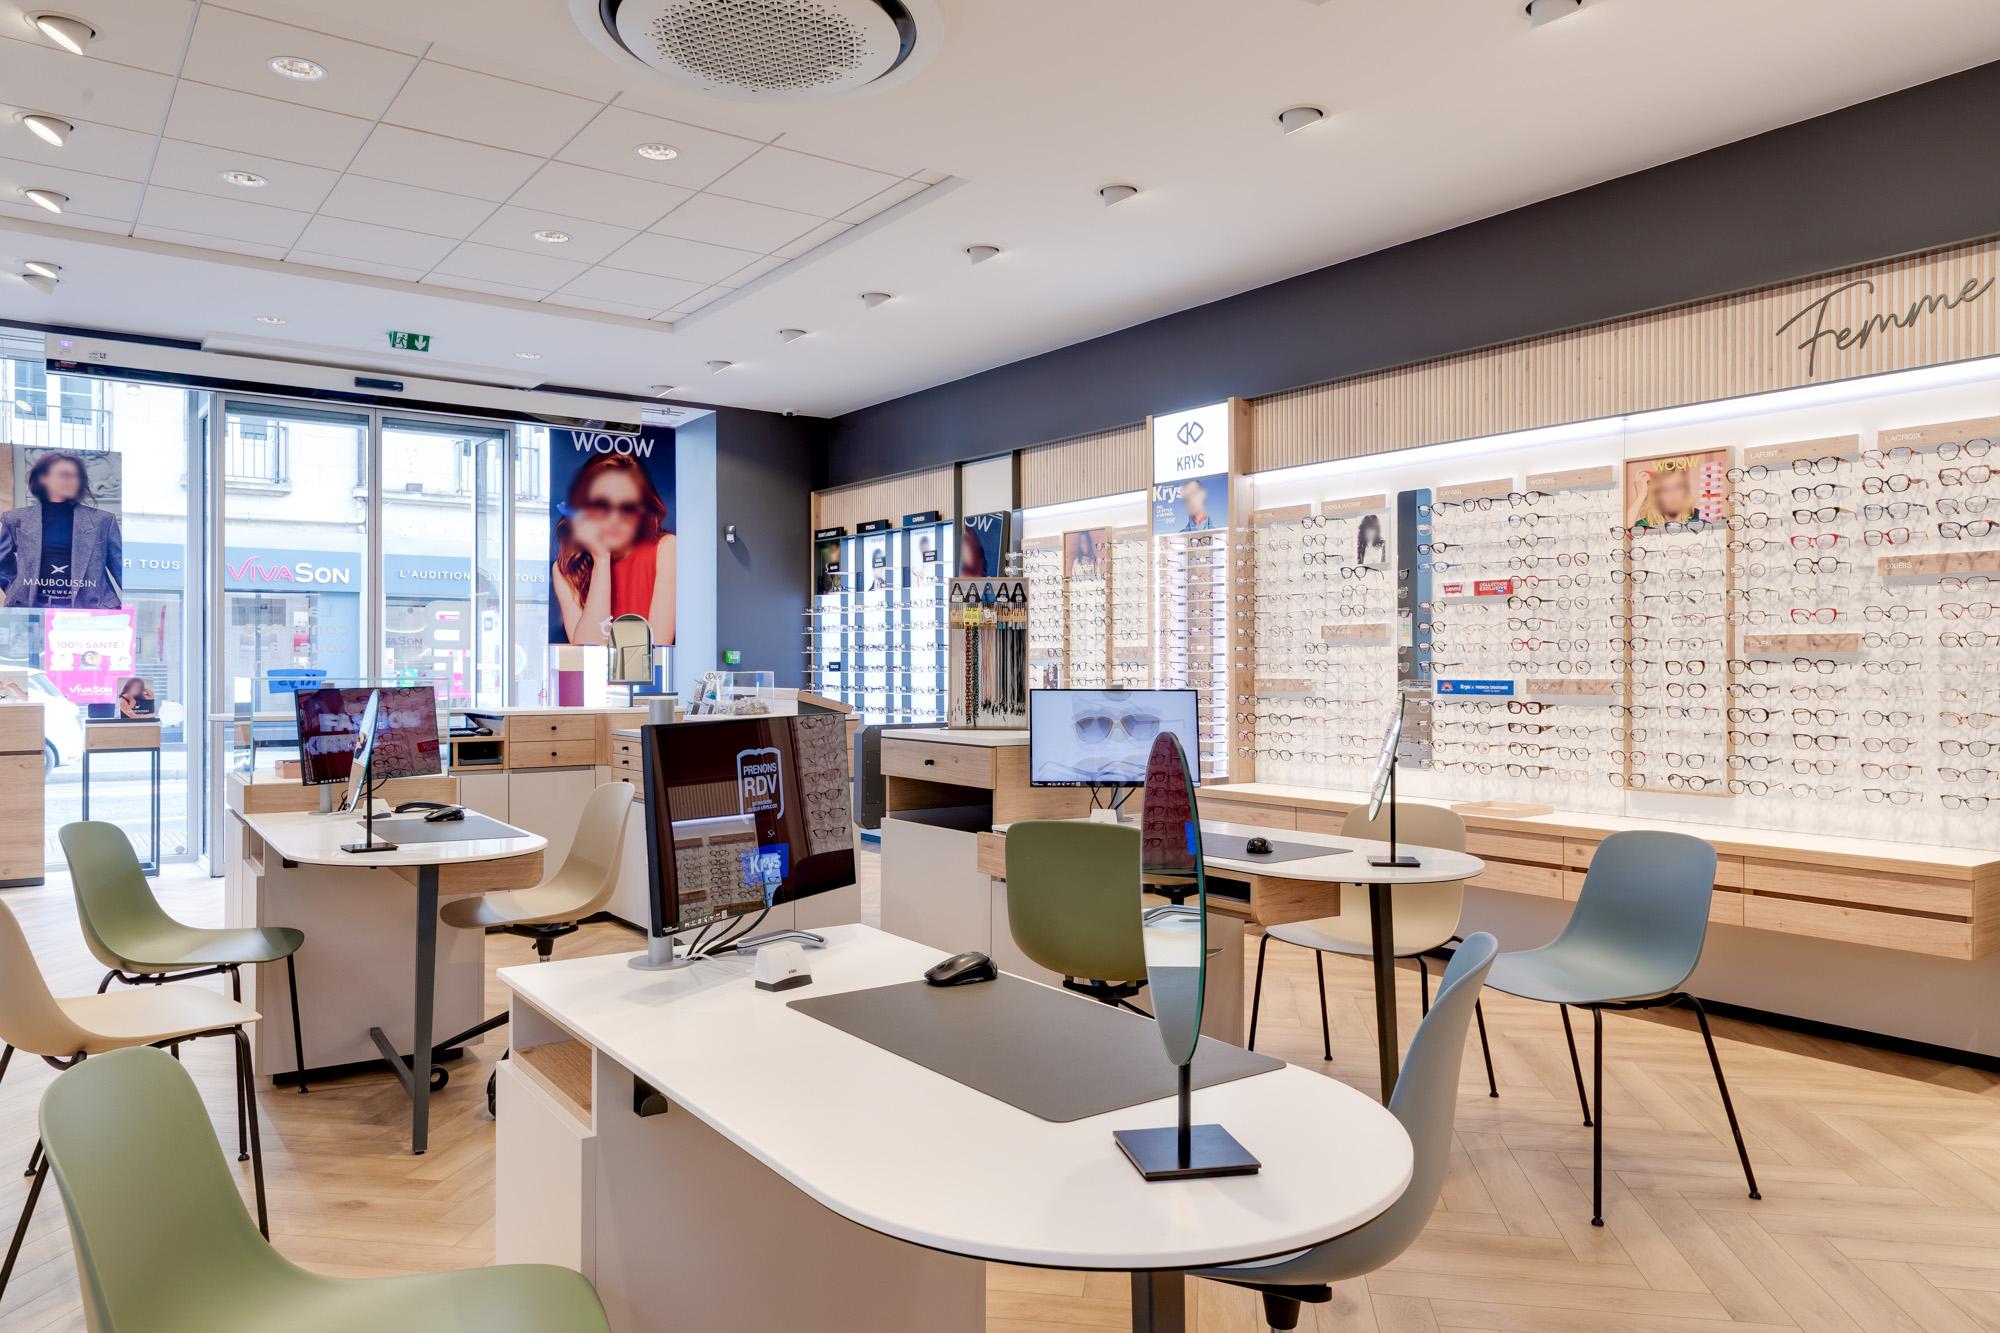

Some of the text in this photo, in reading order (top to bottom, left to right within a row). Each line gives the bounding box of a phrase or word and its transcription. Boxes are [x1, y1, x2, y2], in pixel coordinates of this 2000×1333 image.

[1775, 279, 1996, 378] Femme
[571, 431, 655, 458] WOOW
[1176, 453, 1205, 472] KRYS
[1653, 456, 1700, 472] WOOW
[1153, 484, 1184, 504] Krys
[140, 559, 181, 570] TOUS
[400, 569, 471, 580] L'AUDITION
[515, 573, 545, 583] TOUS
[23, 578, 97, 588] MAUBOUSSIN
[743, 763, 777, 775] PRENONS
[744, 774, 777, 798] RDV
